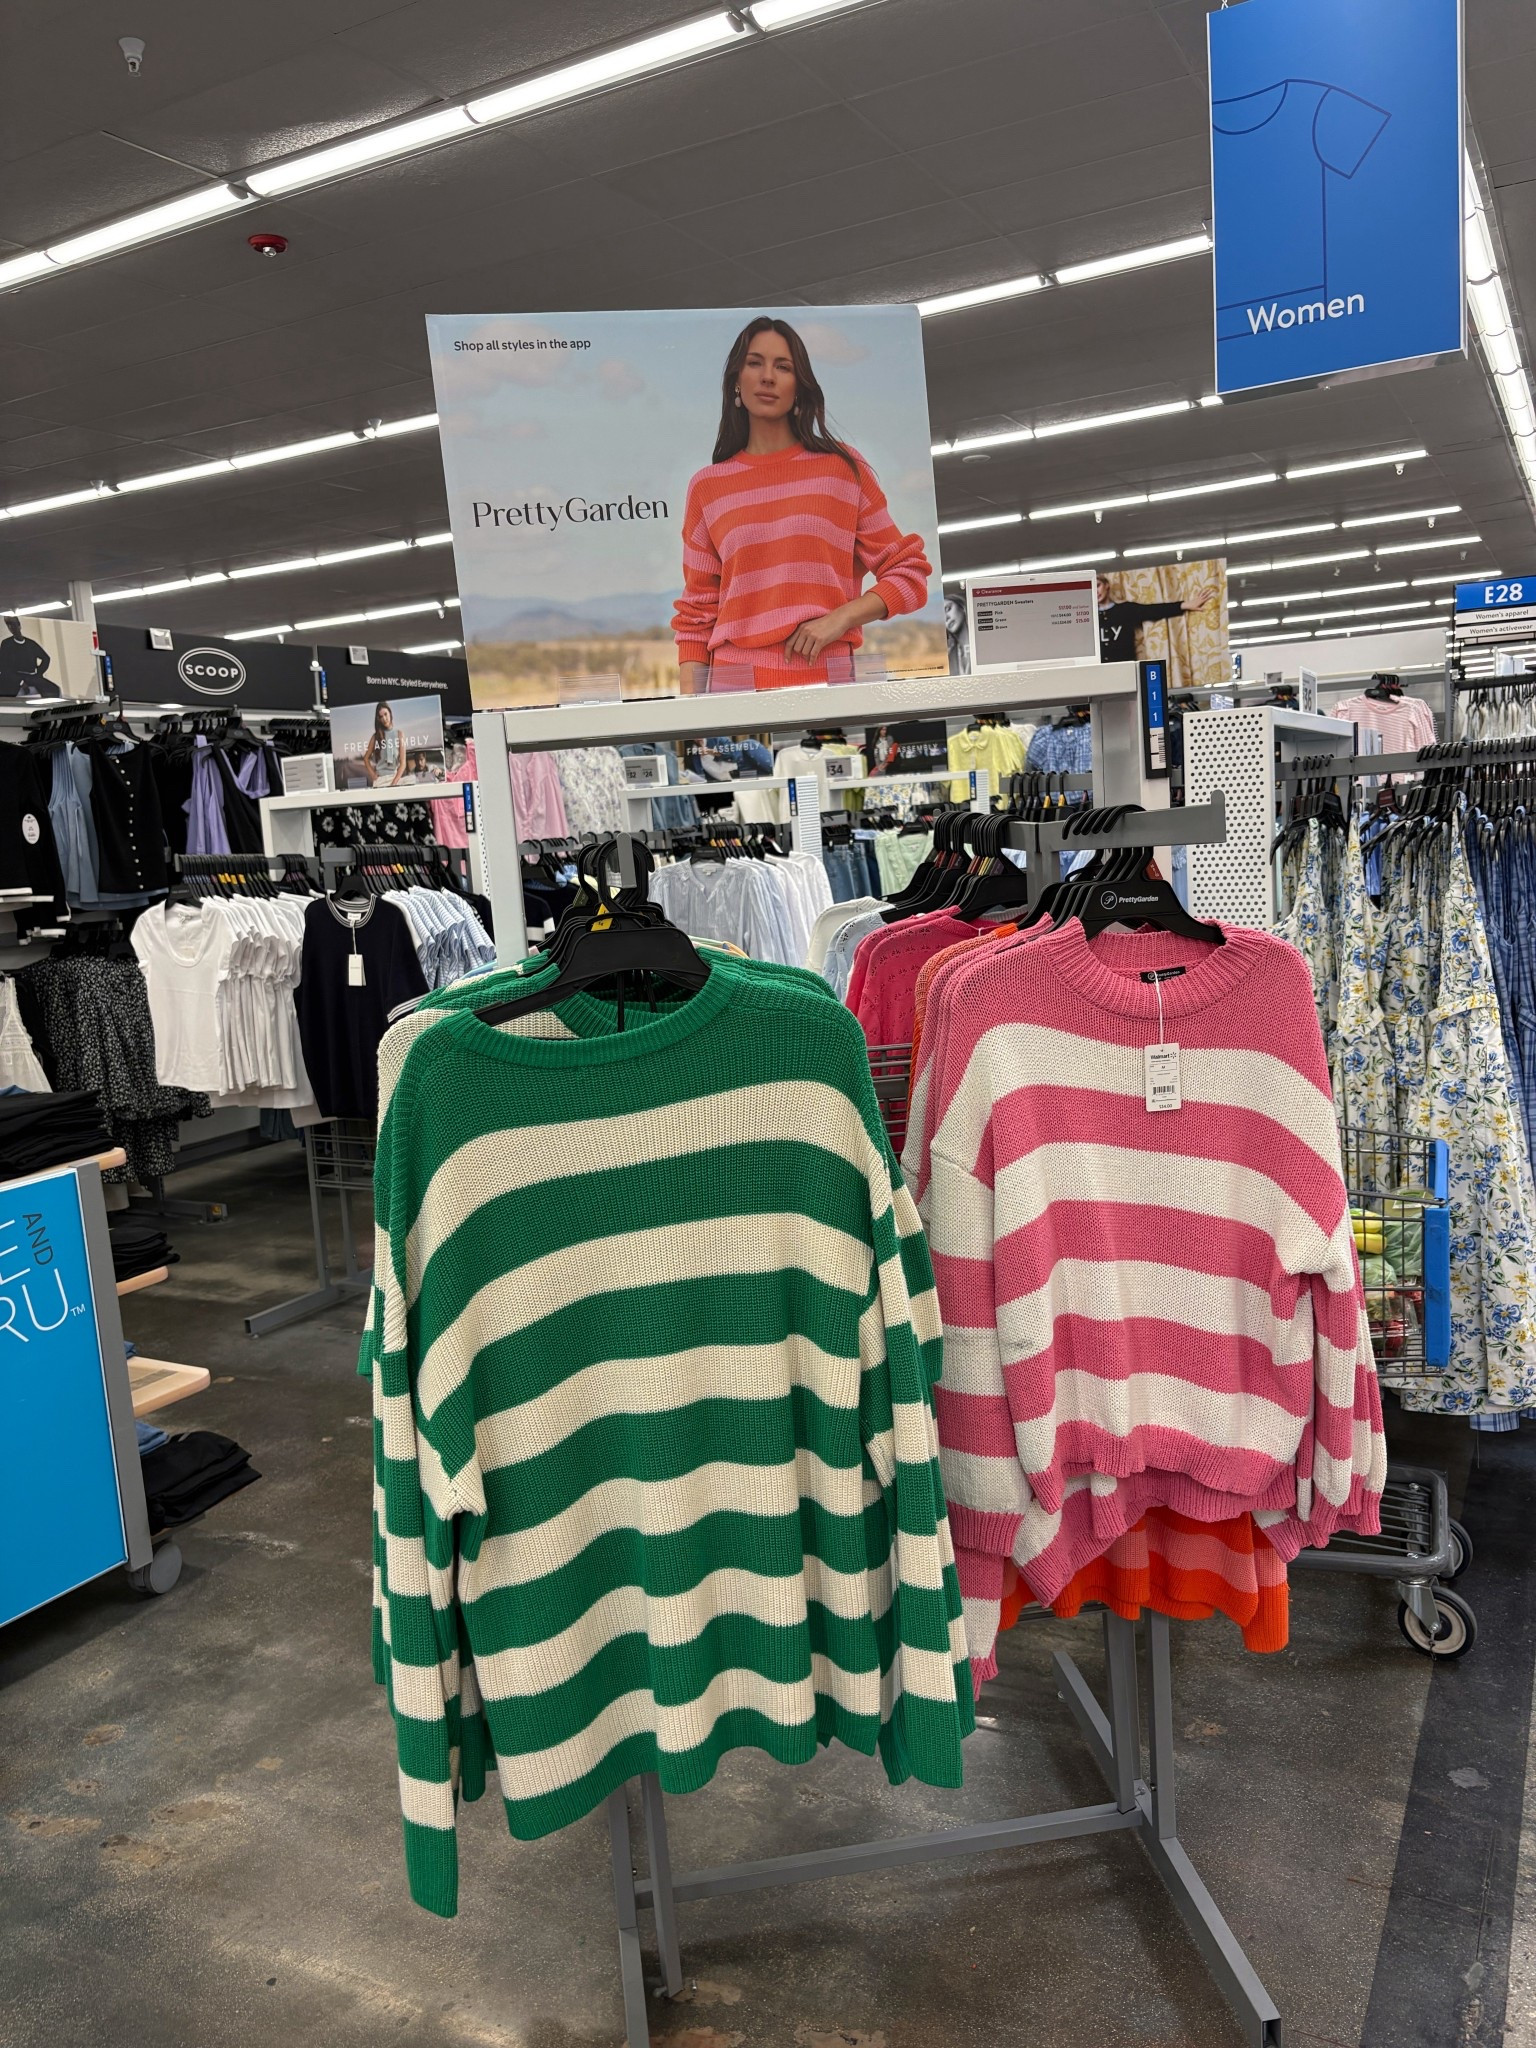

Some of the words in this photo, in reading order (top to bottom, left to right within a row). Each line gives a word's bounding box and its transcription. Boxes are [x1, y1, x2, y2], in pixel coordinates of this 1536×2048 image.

[1247, 293, 1365, 335] Women
[454, 340, 484, 353] Shop
[486, 340, 500, 351] all
[502, 339, 535, 352] styles
[536, 339, 547, 350] in
[549, 339, 568, 350] the
[570, 340, 591, 351] app
[472, 494, 669, 532] PrettyGarden
[1484, 582, 1523, 604] E28
[1475, 611, 1504, 620] Women's
[1505, 609, 1529, 618] apparel
[1469, 626, 1498, 635] Women's
[1498, 624, 1534, 632] activewear
[185, 663, 239, 679] SCOOP
[1150, 671, 1157, 680] B
[366, 675, 381, 685] Born
[400, 678, 418, 688] Styled
[344, 741, 369, 753] FREE
[374, 735, 430, 750] ASSEMBLY
[686, 746, 708, 756] FREE
[713, 742, 760, 753] ASSEMBLY
[897, 743, 938, 753] ASSEMBLY
[1118, 895, 1159, 904] PrettyGarden
[22, 1212, 54, 1266] AND
